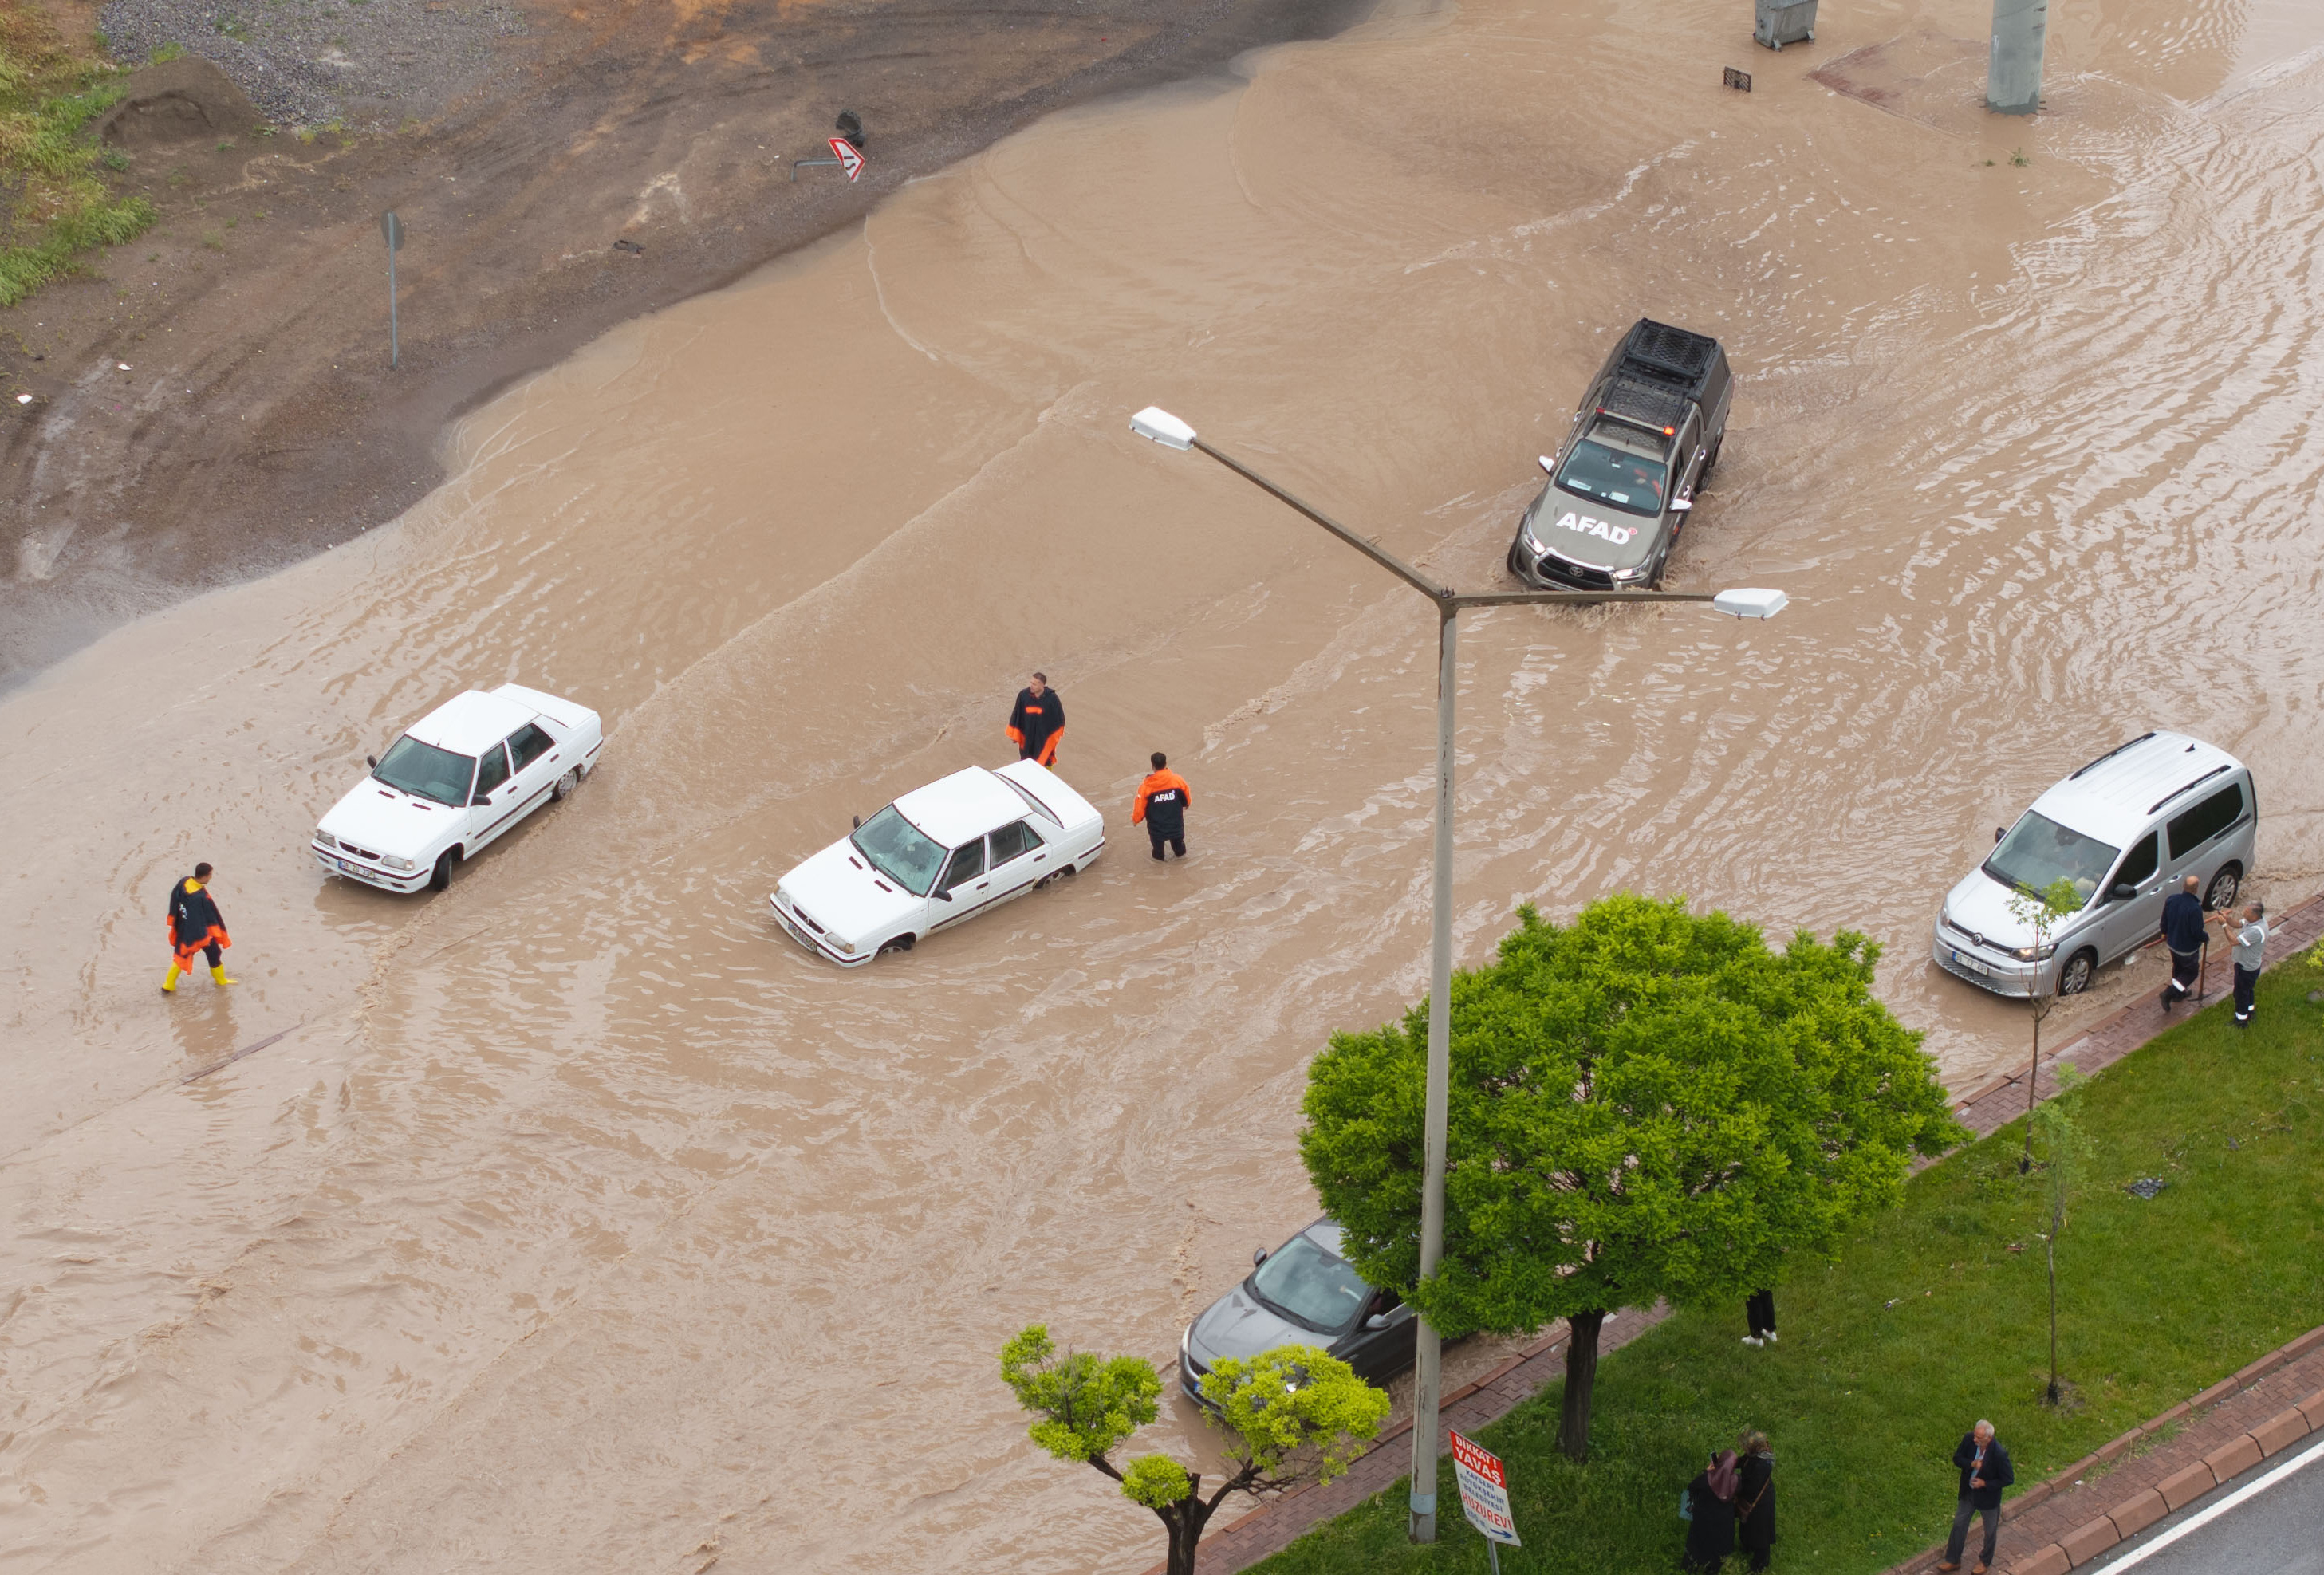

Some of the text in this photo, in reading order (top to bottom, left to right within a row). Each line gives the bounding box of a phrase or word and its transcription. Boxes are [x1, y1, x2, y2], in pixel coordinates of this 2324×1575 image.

[1556, 512, 1630, 545] AFAD
[1154, 793, 1176, 803] AFAD
[1455, 1435, 1491, 1464] DİKKAT
[1455, 1446, 1502, 1486] YAVAŞ
[1462, 1490, 1513, 1530] HUZUREVİ
